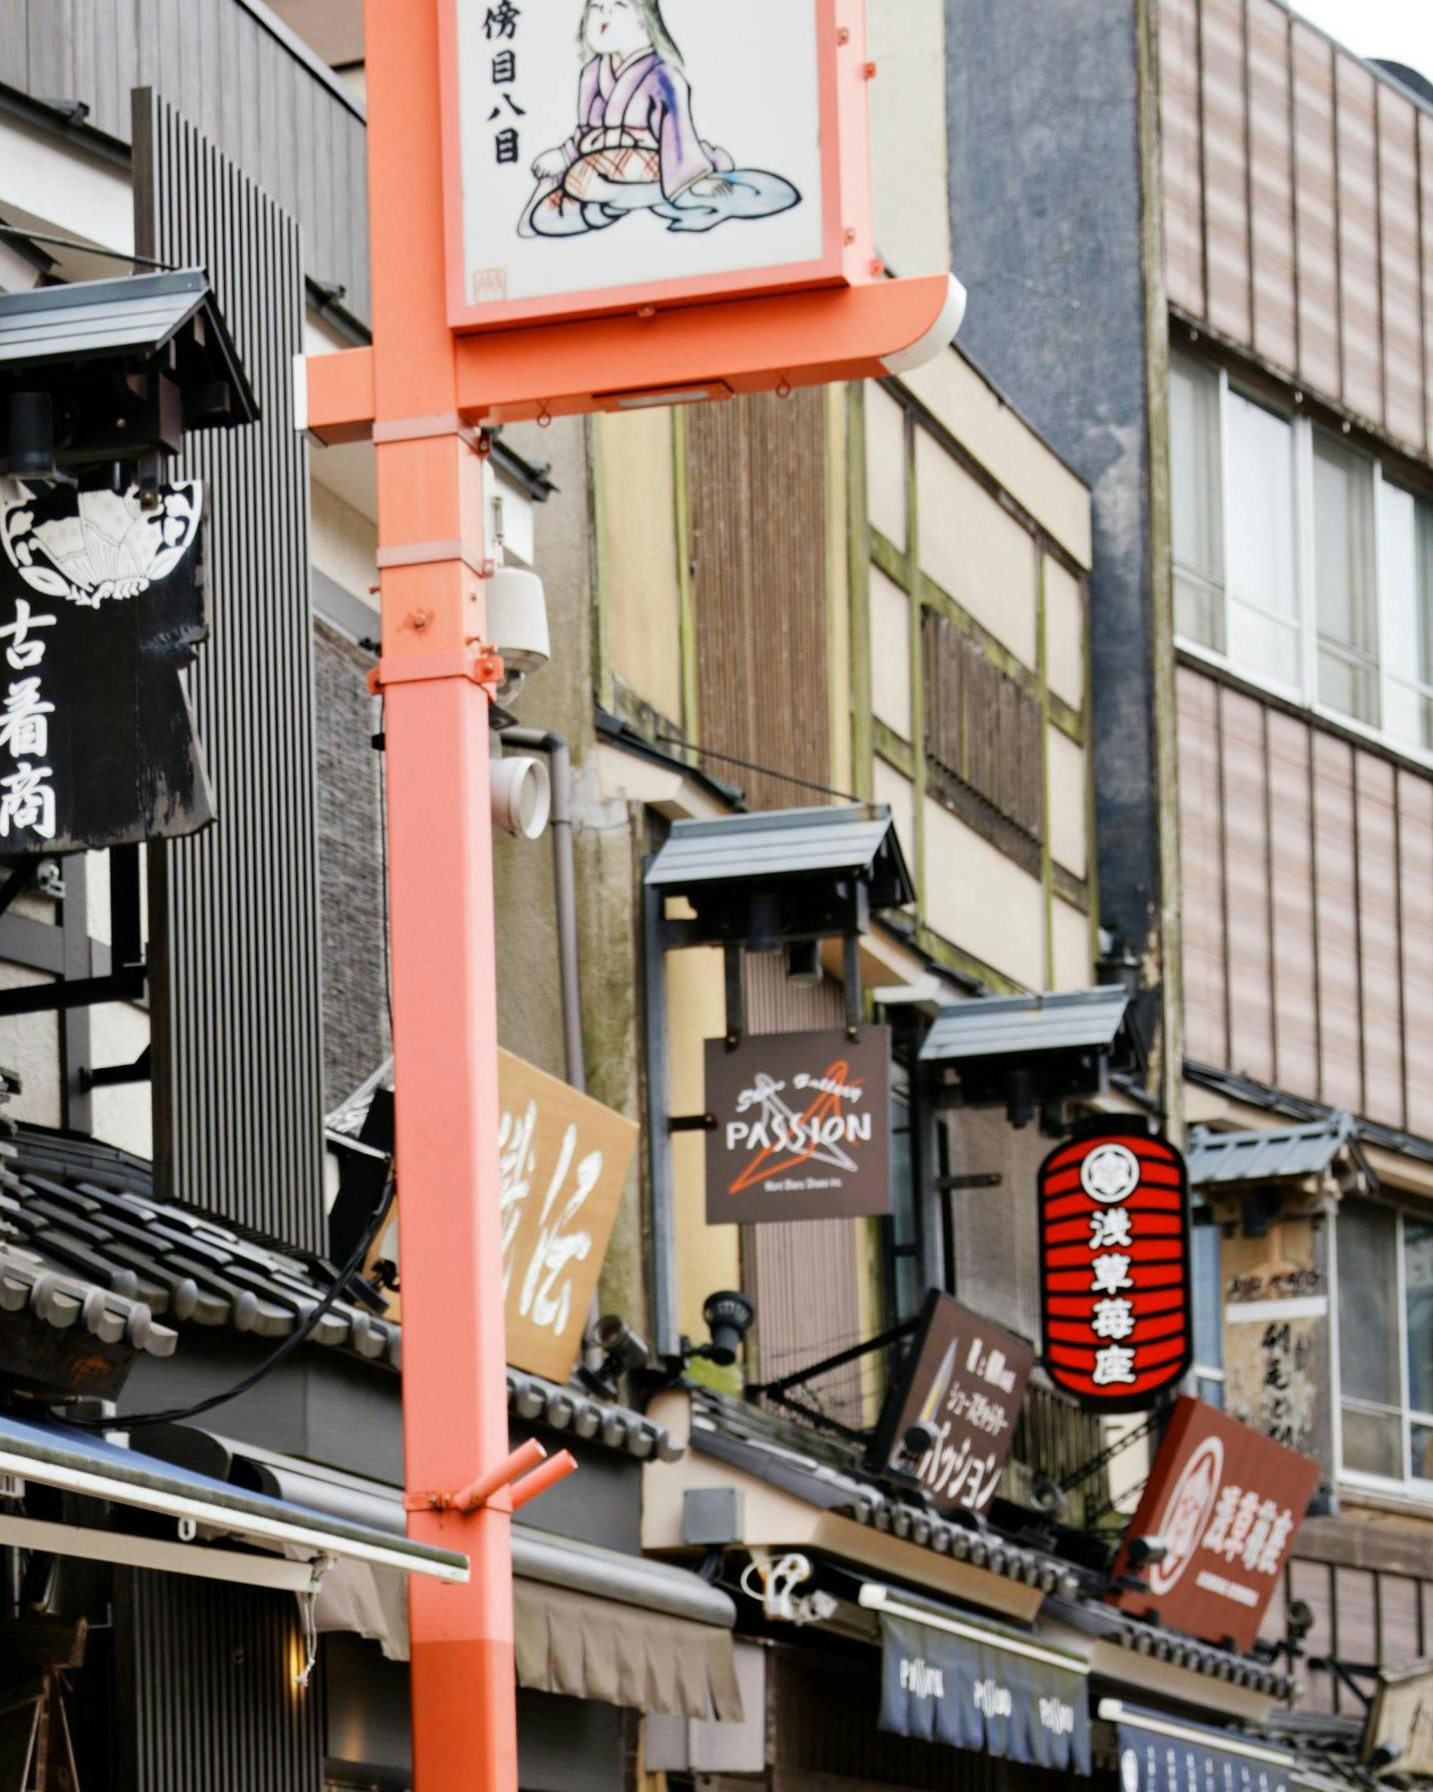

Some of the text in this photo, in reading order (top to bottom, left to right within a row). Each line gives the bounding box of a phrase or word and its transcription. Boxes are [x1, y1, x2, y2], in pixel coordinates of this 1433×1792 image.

[726, 1112, 872, 1152] PASSION
[1088, 1208, 1136, 1385] 浅草苺座
